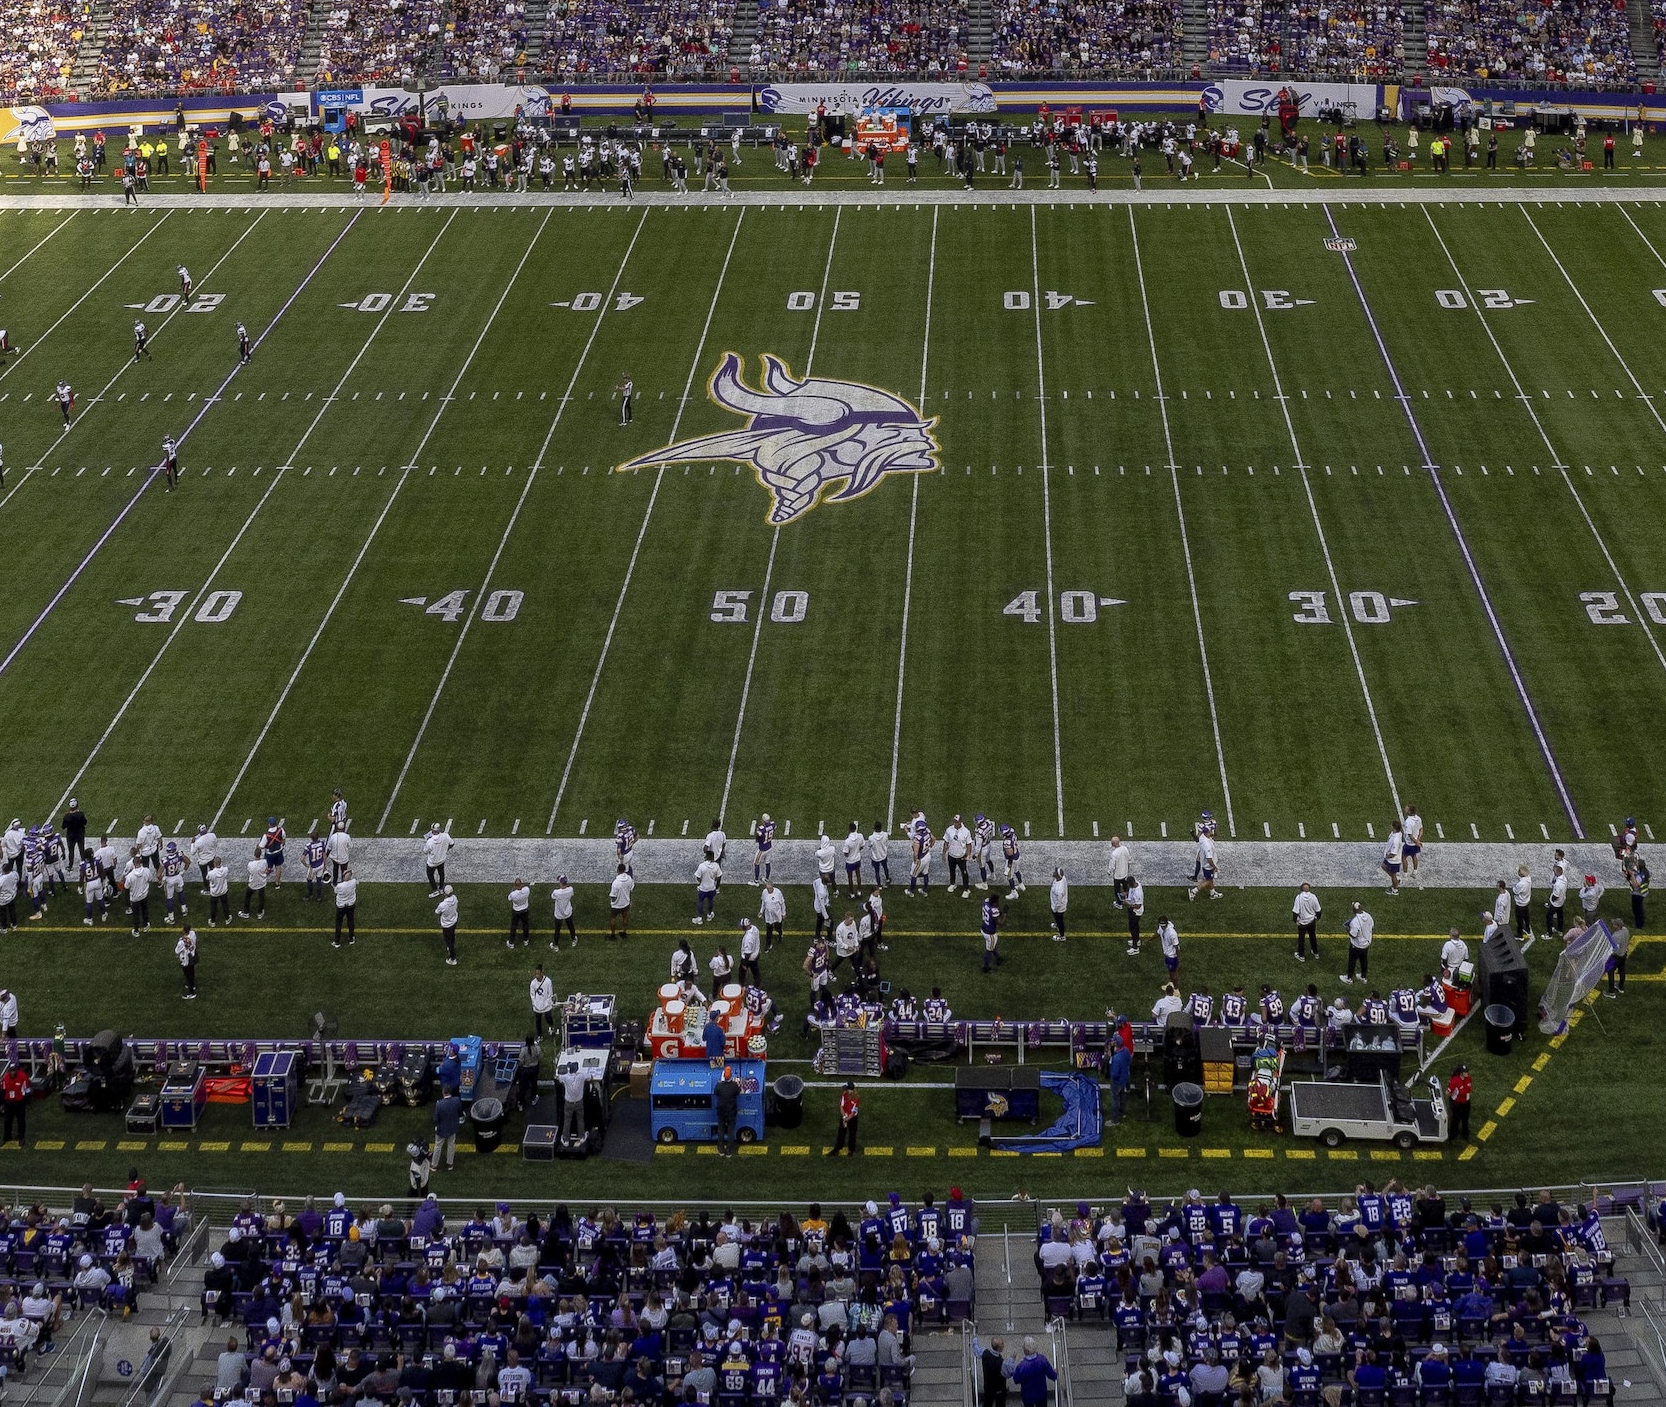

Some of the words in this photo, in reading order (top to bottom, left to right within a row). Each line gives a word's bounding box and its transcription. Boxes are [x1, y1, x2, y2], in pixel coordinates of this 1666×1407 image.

[326, 94, 342, 102] CBS
[344, 93, 361, 102] NFL
[144, 293, 226, 314] 20
[358, 292, 436, 313] 30
[571, 292, 645, 312] 40
[786, 291, 861, 311] 50
[1003, 290, 1075, 311] 40
[1219, 290, 1294, 310] 30
[1434, 288, 1514, 310] 20
[134, 589, 244, 624] 30
[426, 589, 525, 624] 40
[709, 589, 810, 624] 50
[1001, 590, 1098, 625] 40
[1290, 590, 1391, 625] 30
[1194, 1001, 1209, 1018] 58
[1398, 993, 1414, 1012] 97
